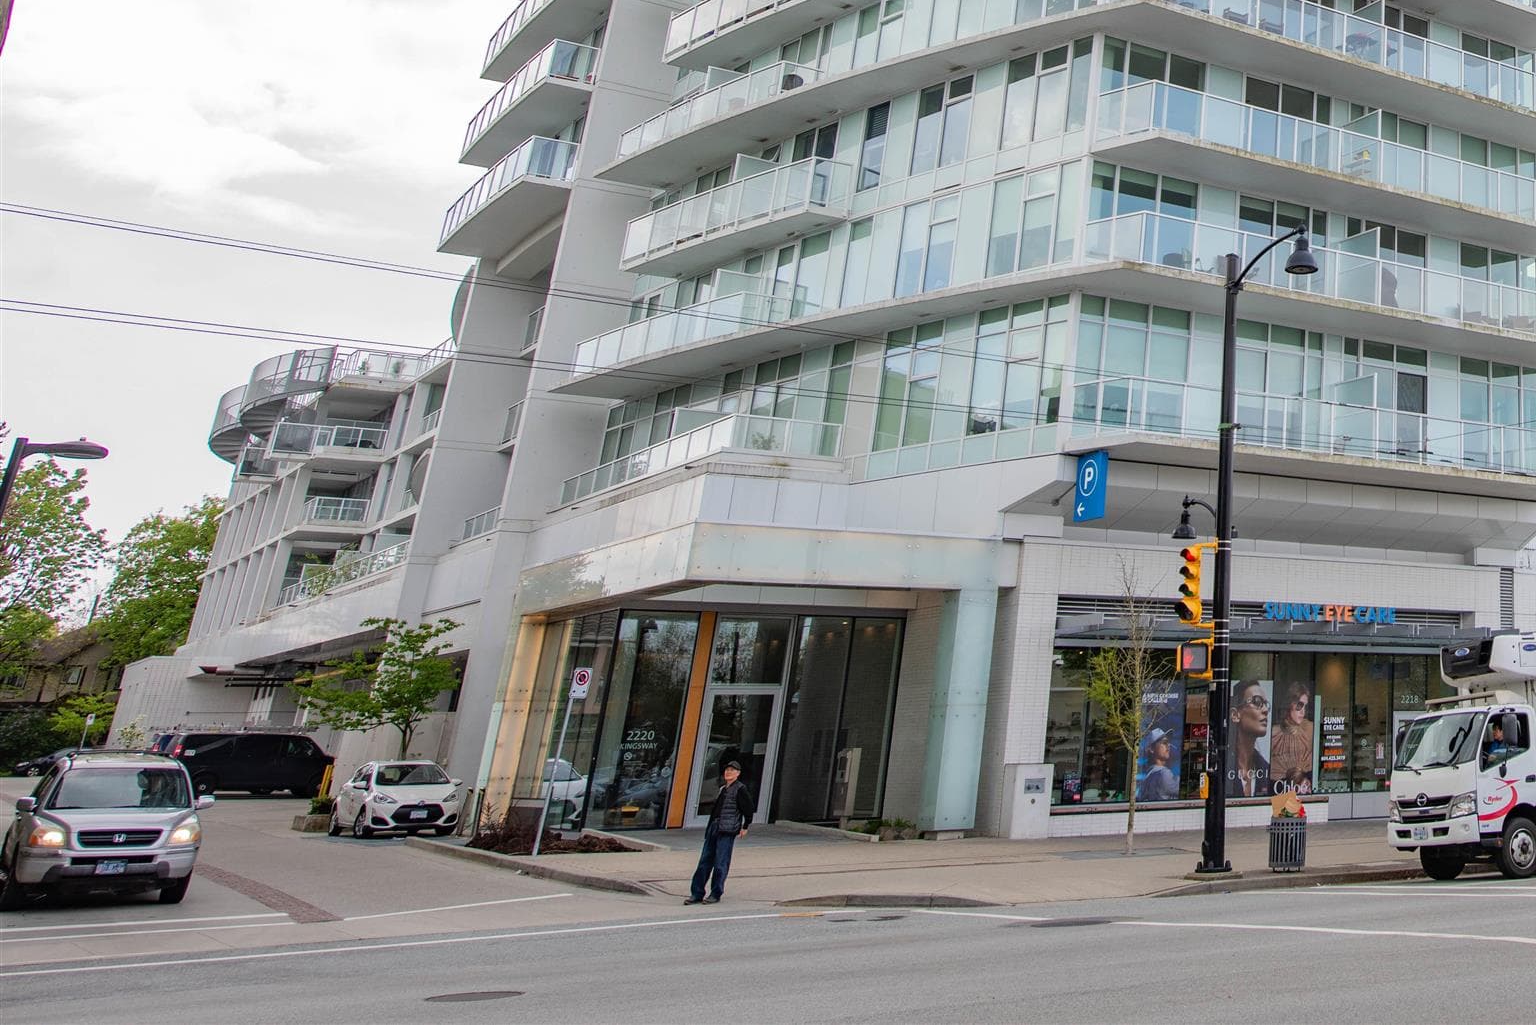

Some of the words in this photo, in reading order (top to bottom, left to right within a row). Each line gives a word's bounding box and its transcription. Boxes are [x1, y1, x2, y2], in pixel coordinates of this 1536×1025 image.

[1083, 466, 1094, 490] P
[1263, 601, 1321, 621] SUNNY
[1324, 604, 1354, 622] EYE
[1354, 606, 1397, 623] CARE
[1399, 695, 1419, 704] 2218
[1323, 716, 1345, 725] SUNNY
[626, 730, 655, 741] 2220
[618, 742, 658, 750] KINGSWAY
[1227, 768, 1269, 780] GUCCI
[1487, 795, 1502, 803] Ryder
